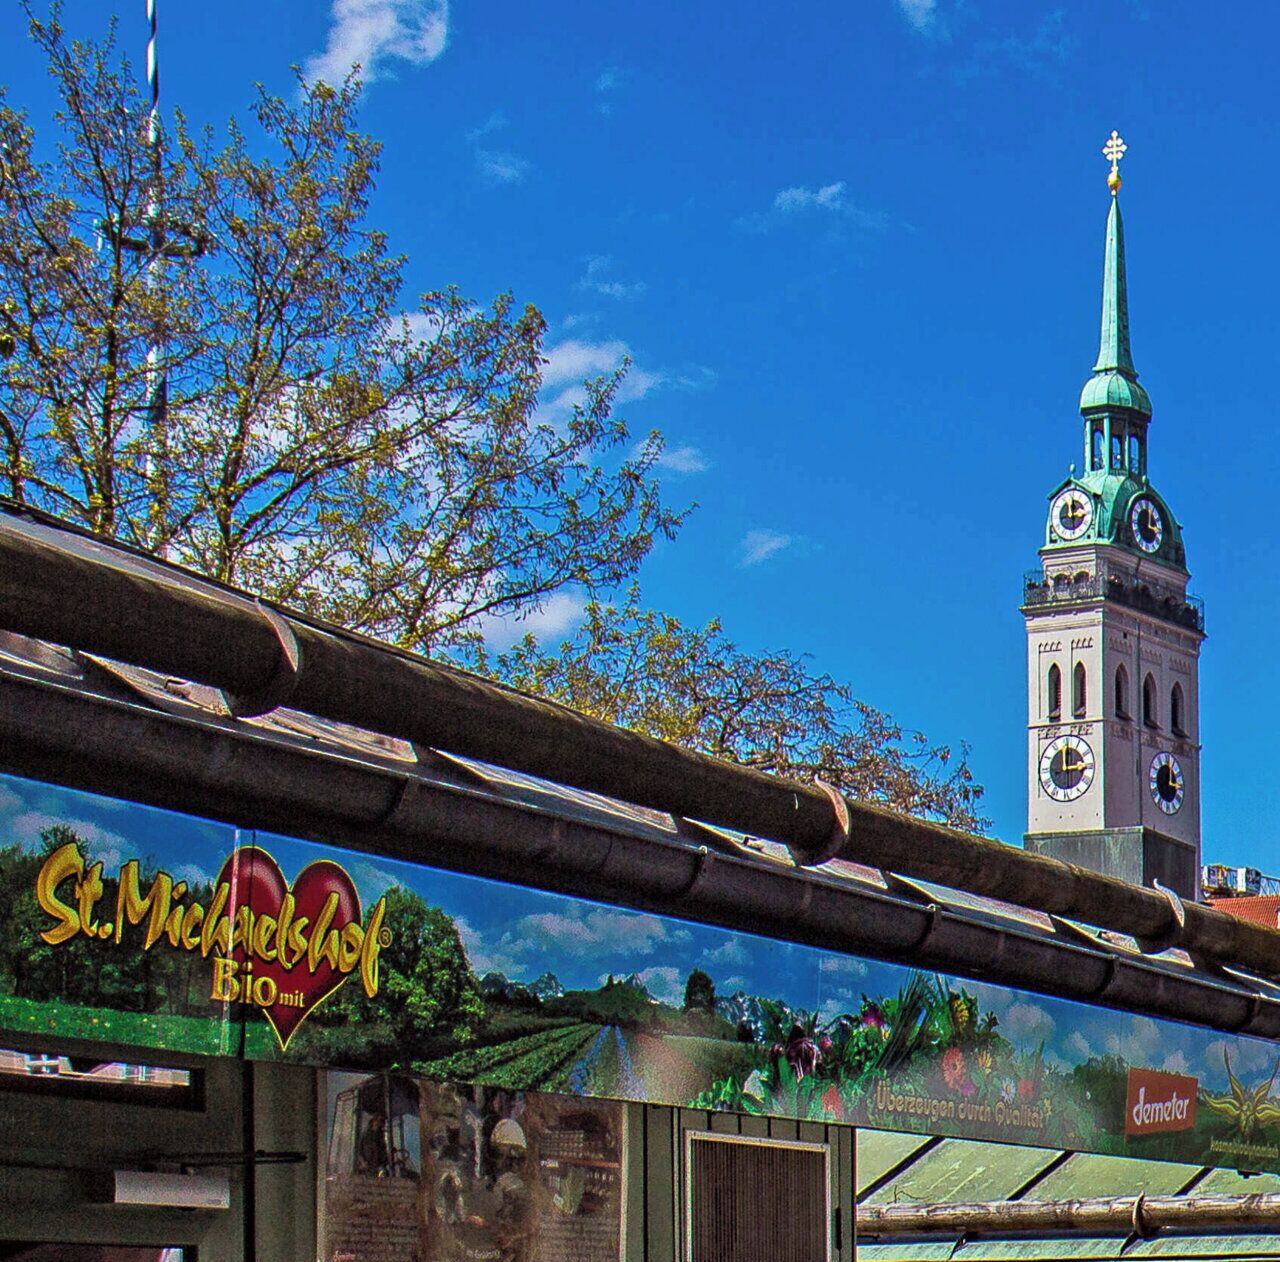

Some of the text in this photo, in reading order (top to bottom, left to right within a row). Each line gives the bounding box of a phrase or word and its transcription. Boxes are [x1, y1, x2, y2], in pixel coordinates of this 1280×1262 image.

[210, 957, 277, 1006] Bio
[876, 1080, 1043, 1129] Überzeugen durch Qualität
[1132, 1087, 1190, 1126] demeter
